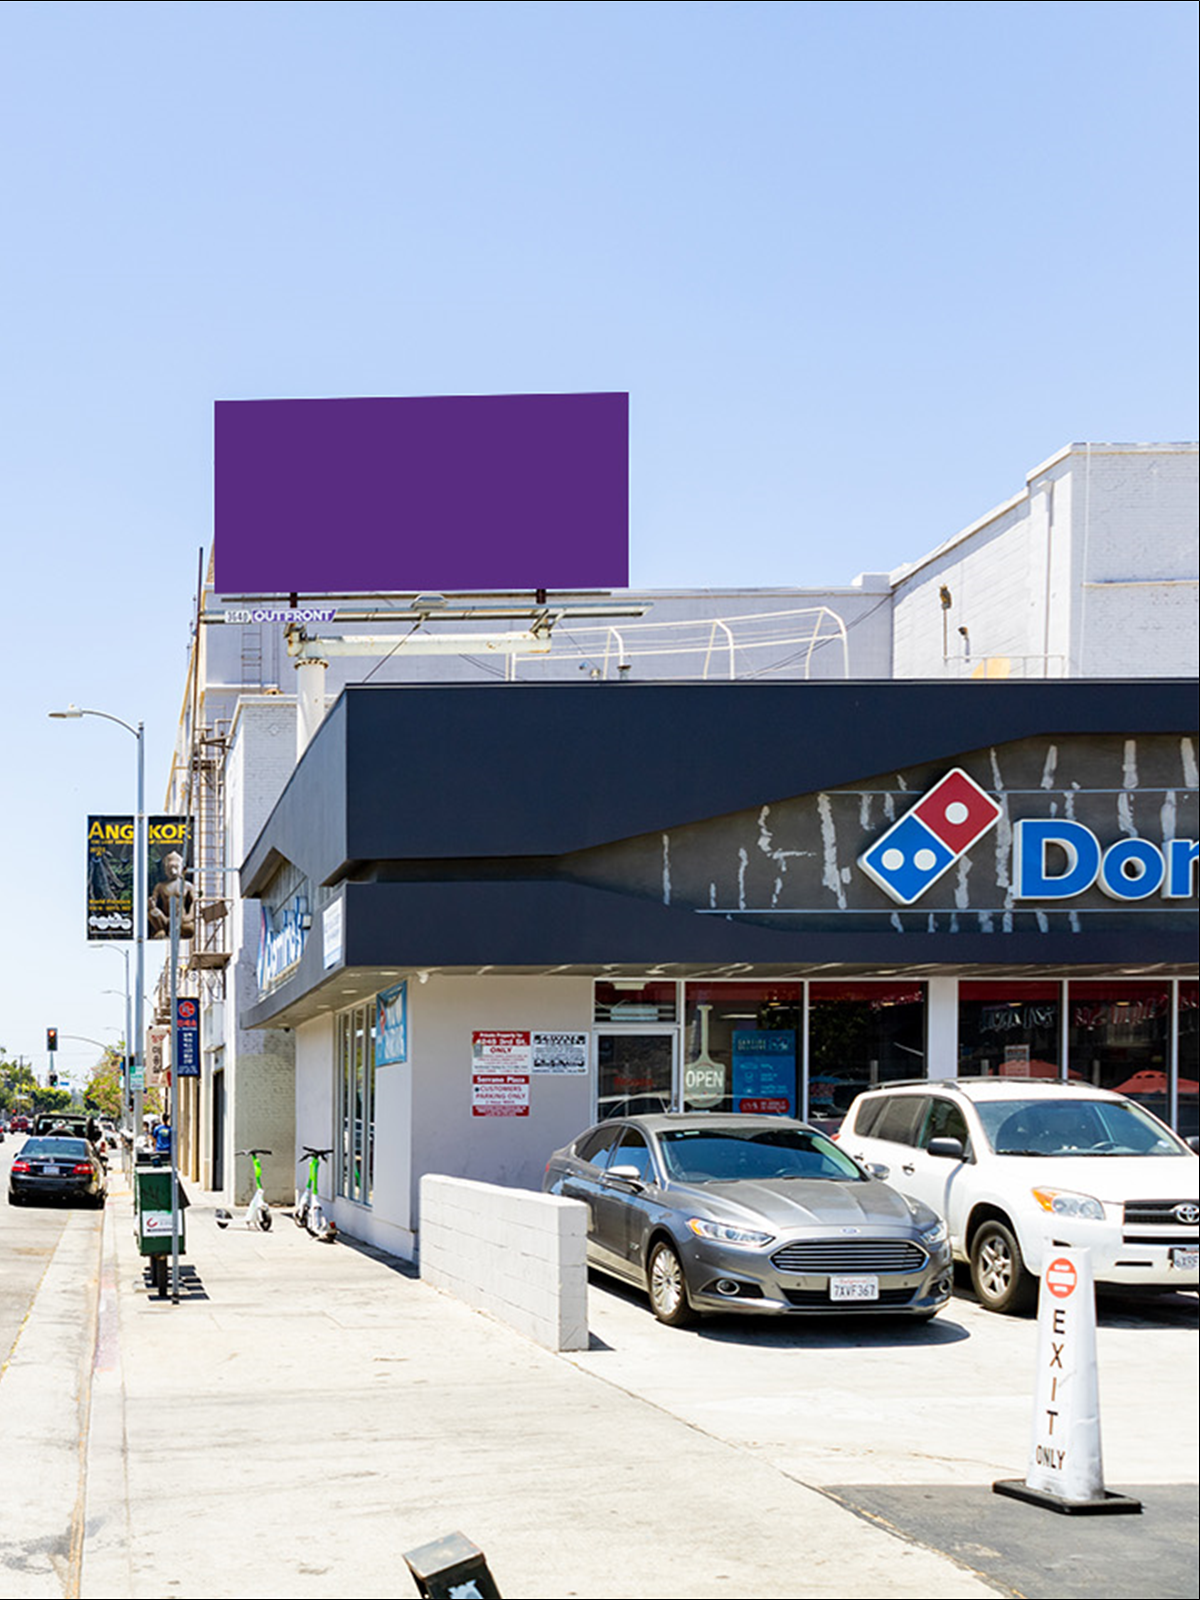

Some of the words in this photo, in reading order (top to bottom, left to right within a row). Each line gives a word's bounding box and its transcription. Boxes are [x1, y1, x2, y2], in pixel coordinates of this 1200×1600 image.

[254, 610, 332, 621] OUTFRONT
[685, 1070, 723, 1088] OPEN
[834, 1284, 876, 1297] 7XVF367
[1046, 1309, 1066, 1436] EXIT
[1036, 1445, 1066, 1470] ONLY
